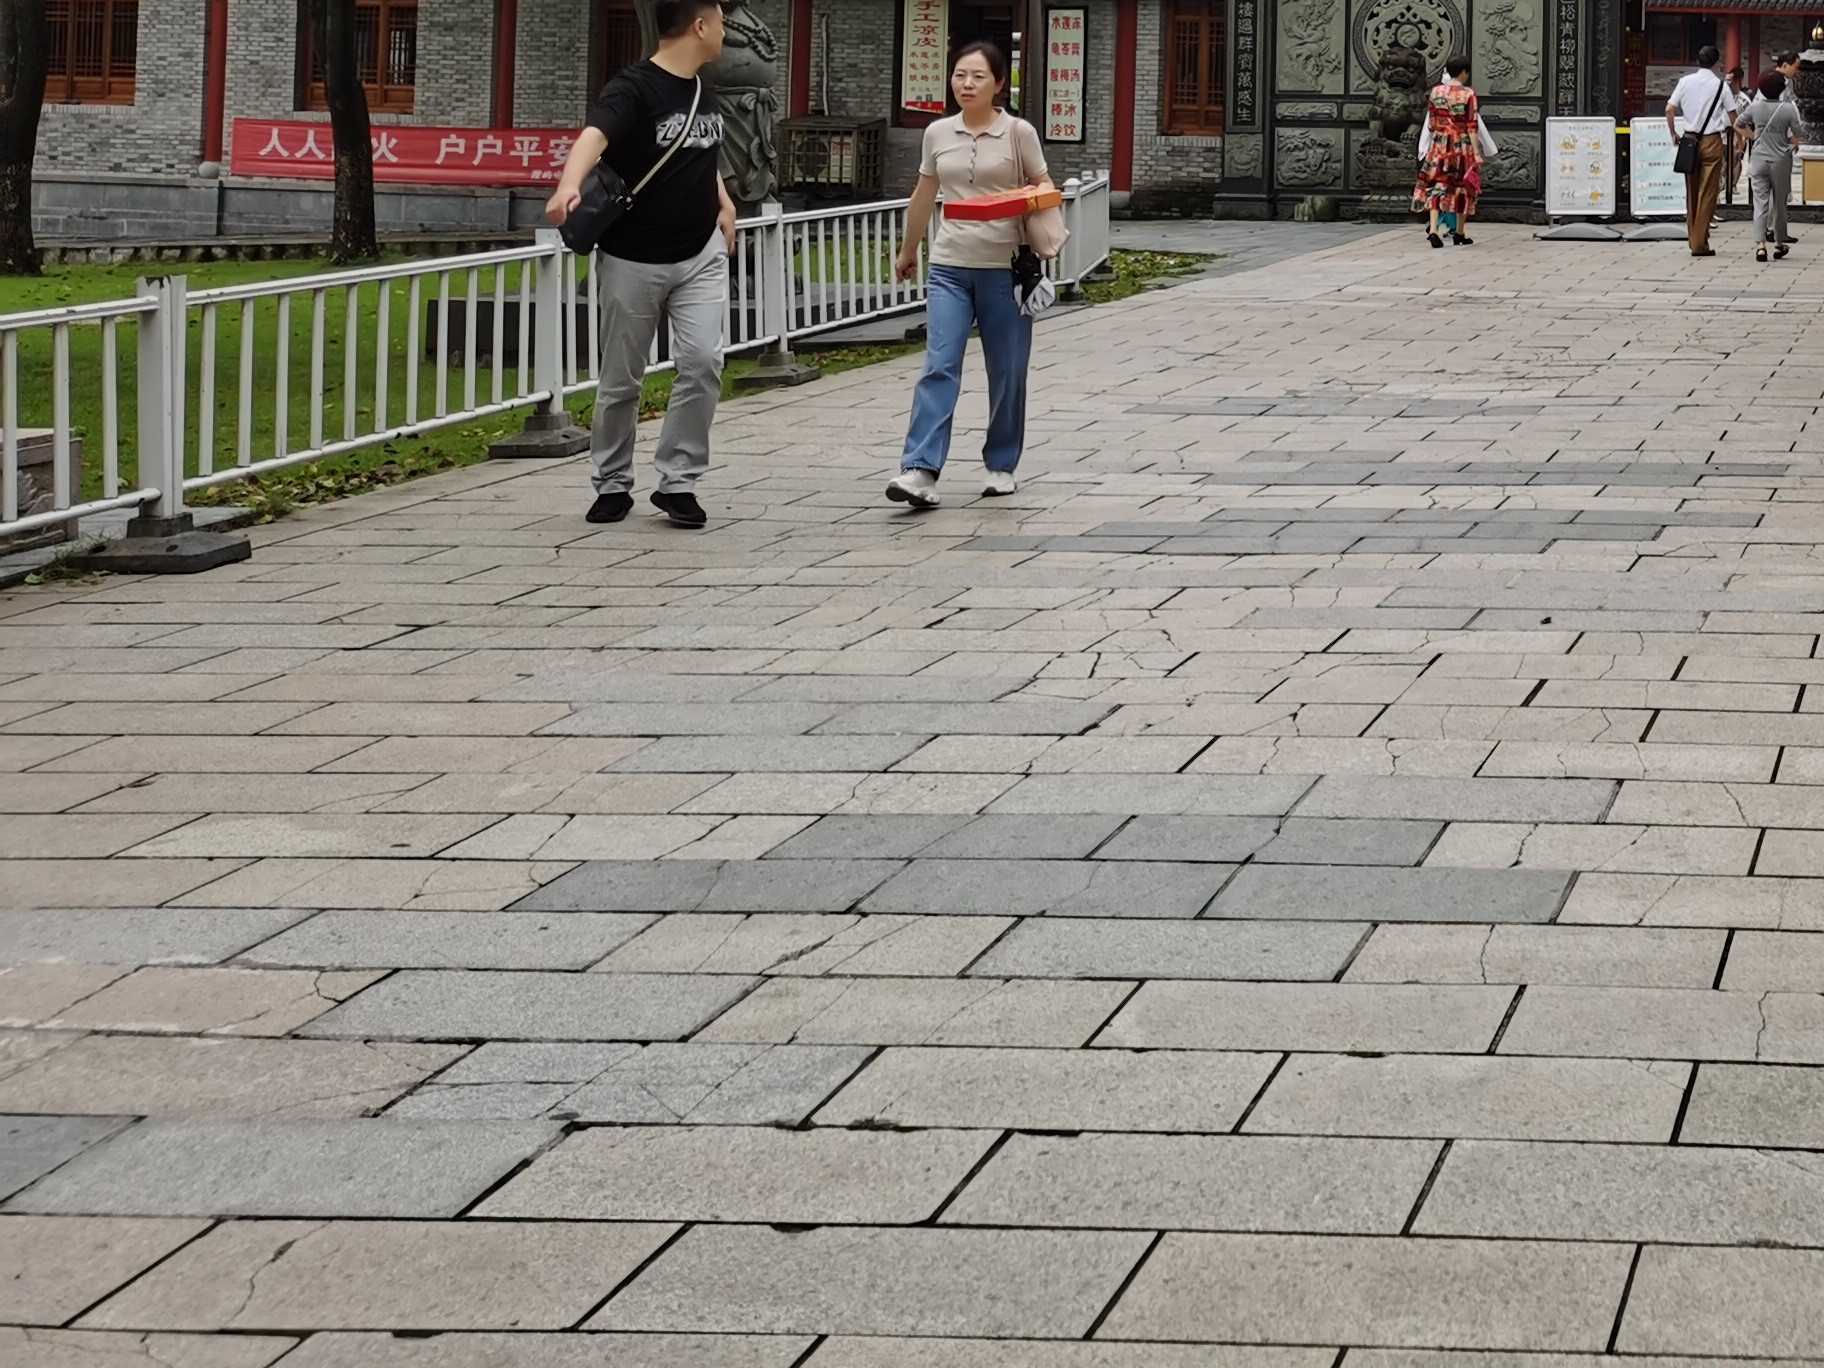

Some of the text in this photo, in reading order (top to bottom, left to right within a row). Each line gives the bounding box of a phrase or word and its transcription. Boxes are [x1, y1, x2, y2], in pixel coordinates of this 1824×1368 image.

[259, 128, 576, 167] 人人火 户户平安
